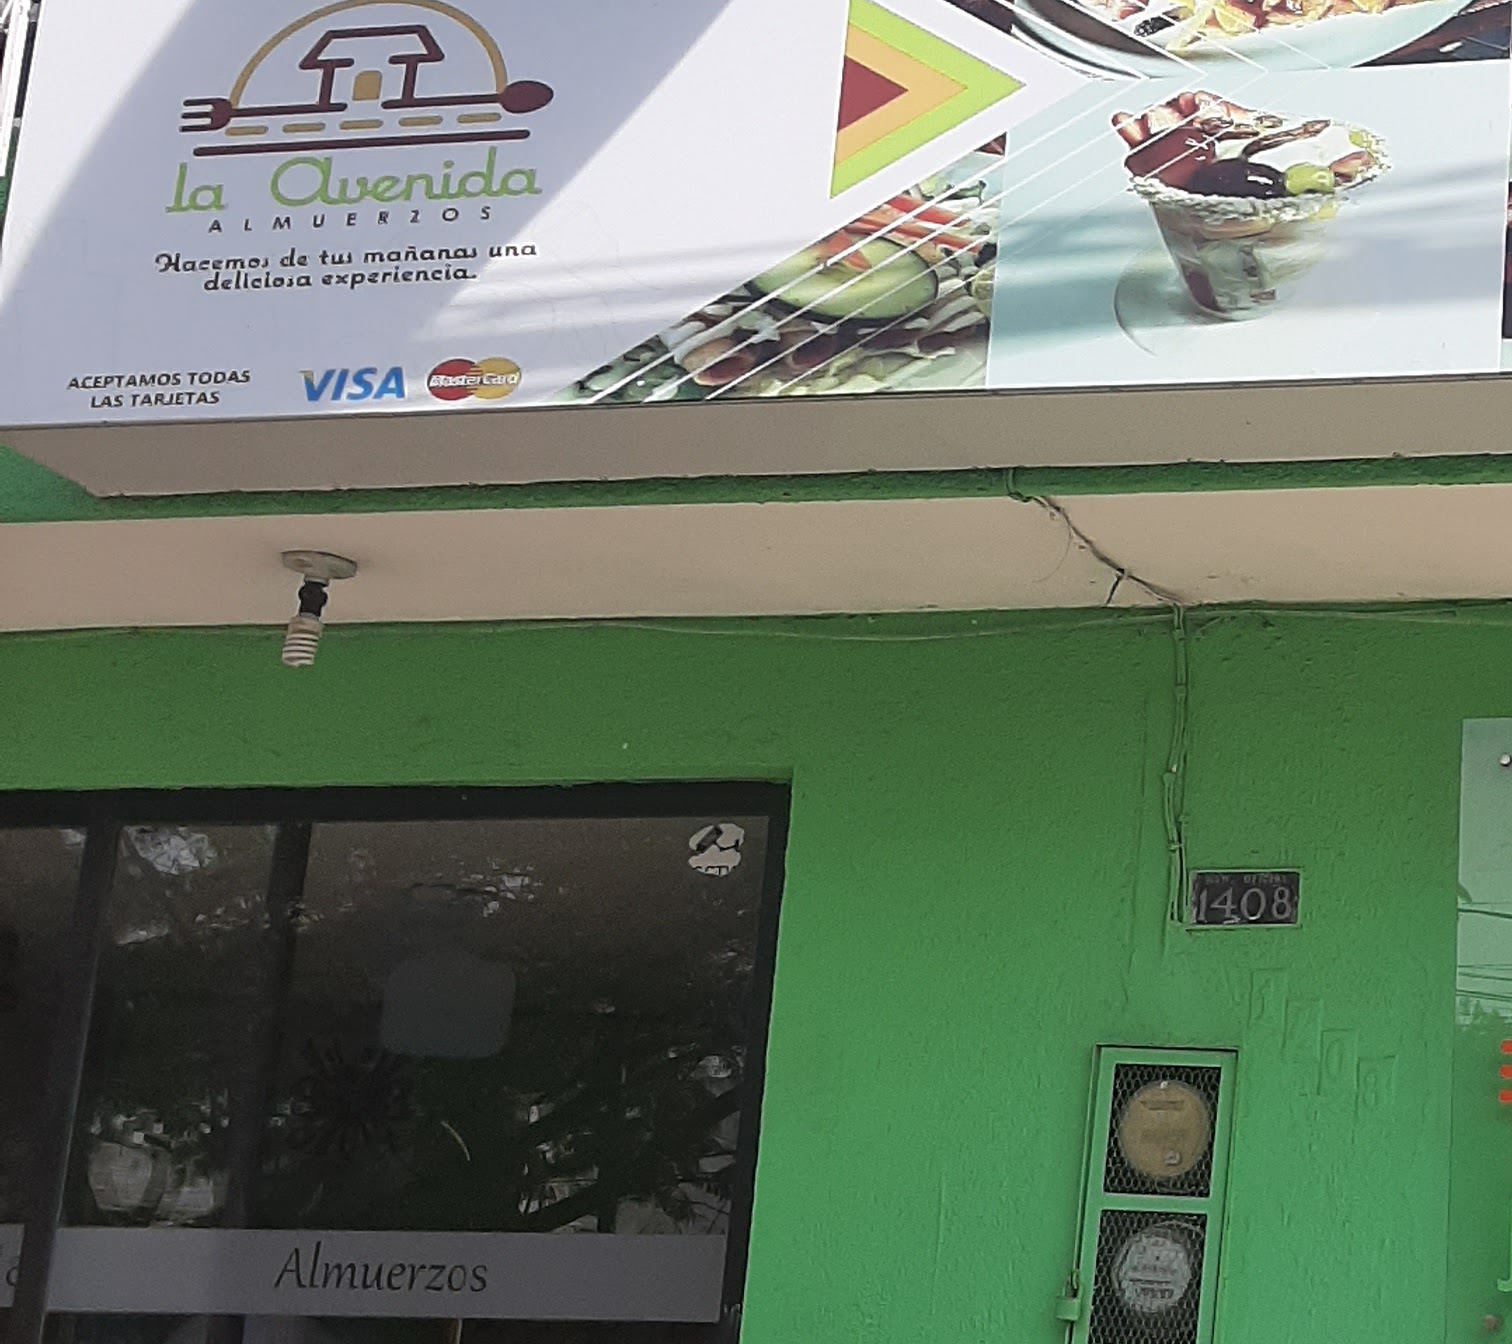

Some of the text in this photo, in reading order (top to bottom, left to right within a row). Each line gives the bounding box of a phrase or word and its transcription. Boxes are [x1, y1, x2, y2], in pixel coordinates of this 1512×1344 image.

[270, 146, 543, 207] Avenida
[207, 206, 492, 234] ALMUERZOS
[154, 244, 538, 275] Hacemos de tus mañanas una
[203, 264, 478, 292] deliciosa experiencia.
[66, 369, 251, 390] ACEPTAMOS TODAS
[299, 366, 407, 402] VISA
[90, 390, 221, 409] LAS TARJETAS
[1197, 887, 1292, 922] 1408
[273, 1240, 489, 1293] Almuerzos
